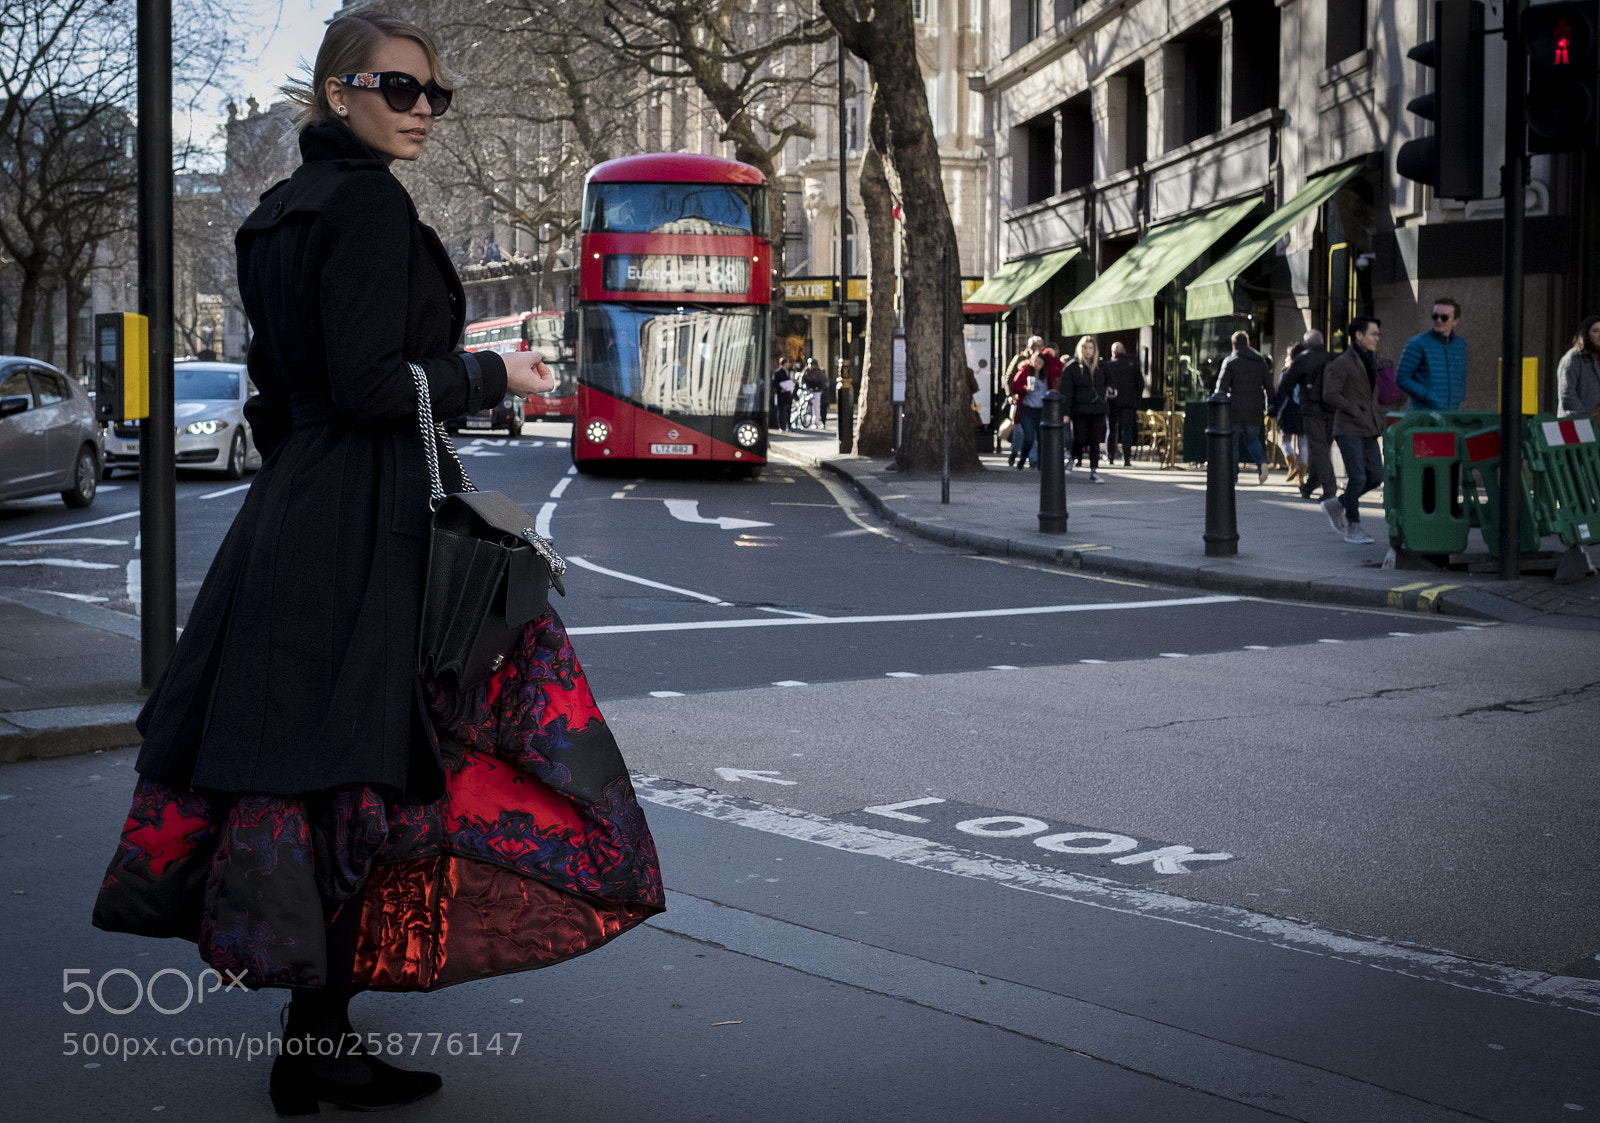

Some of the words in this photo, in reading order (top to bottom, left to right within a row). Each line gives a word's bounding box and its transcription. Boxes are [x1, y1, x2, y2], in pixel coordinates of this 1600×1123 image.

[627, 265, 678, 280] Euston
[710, 264, 737, 285] 68
[863, 796, 1233, 875] LOOK
